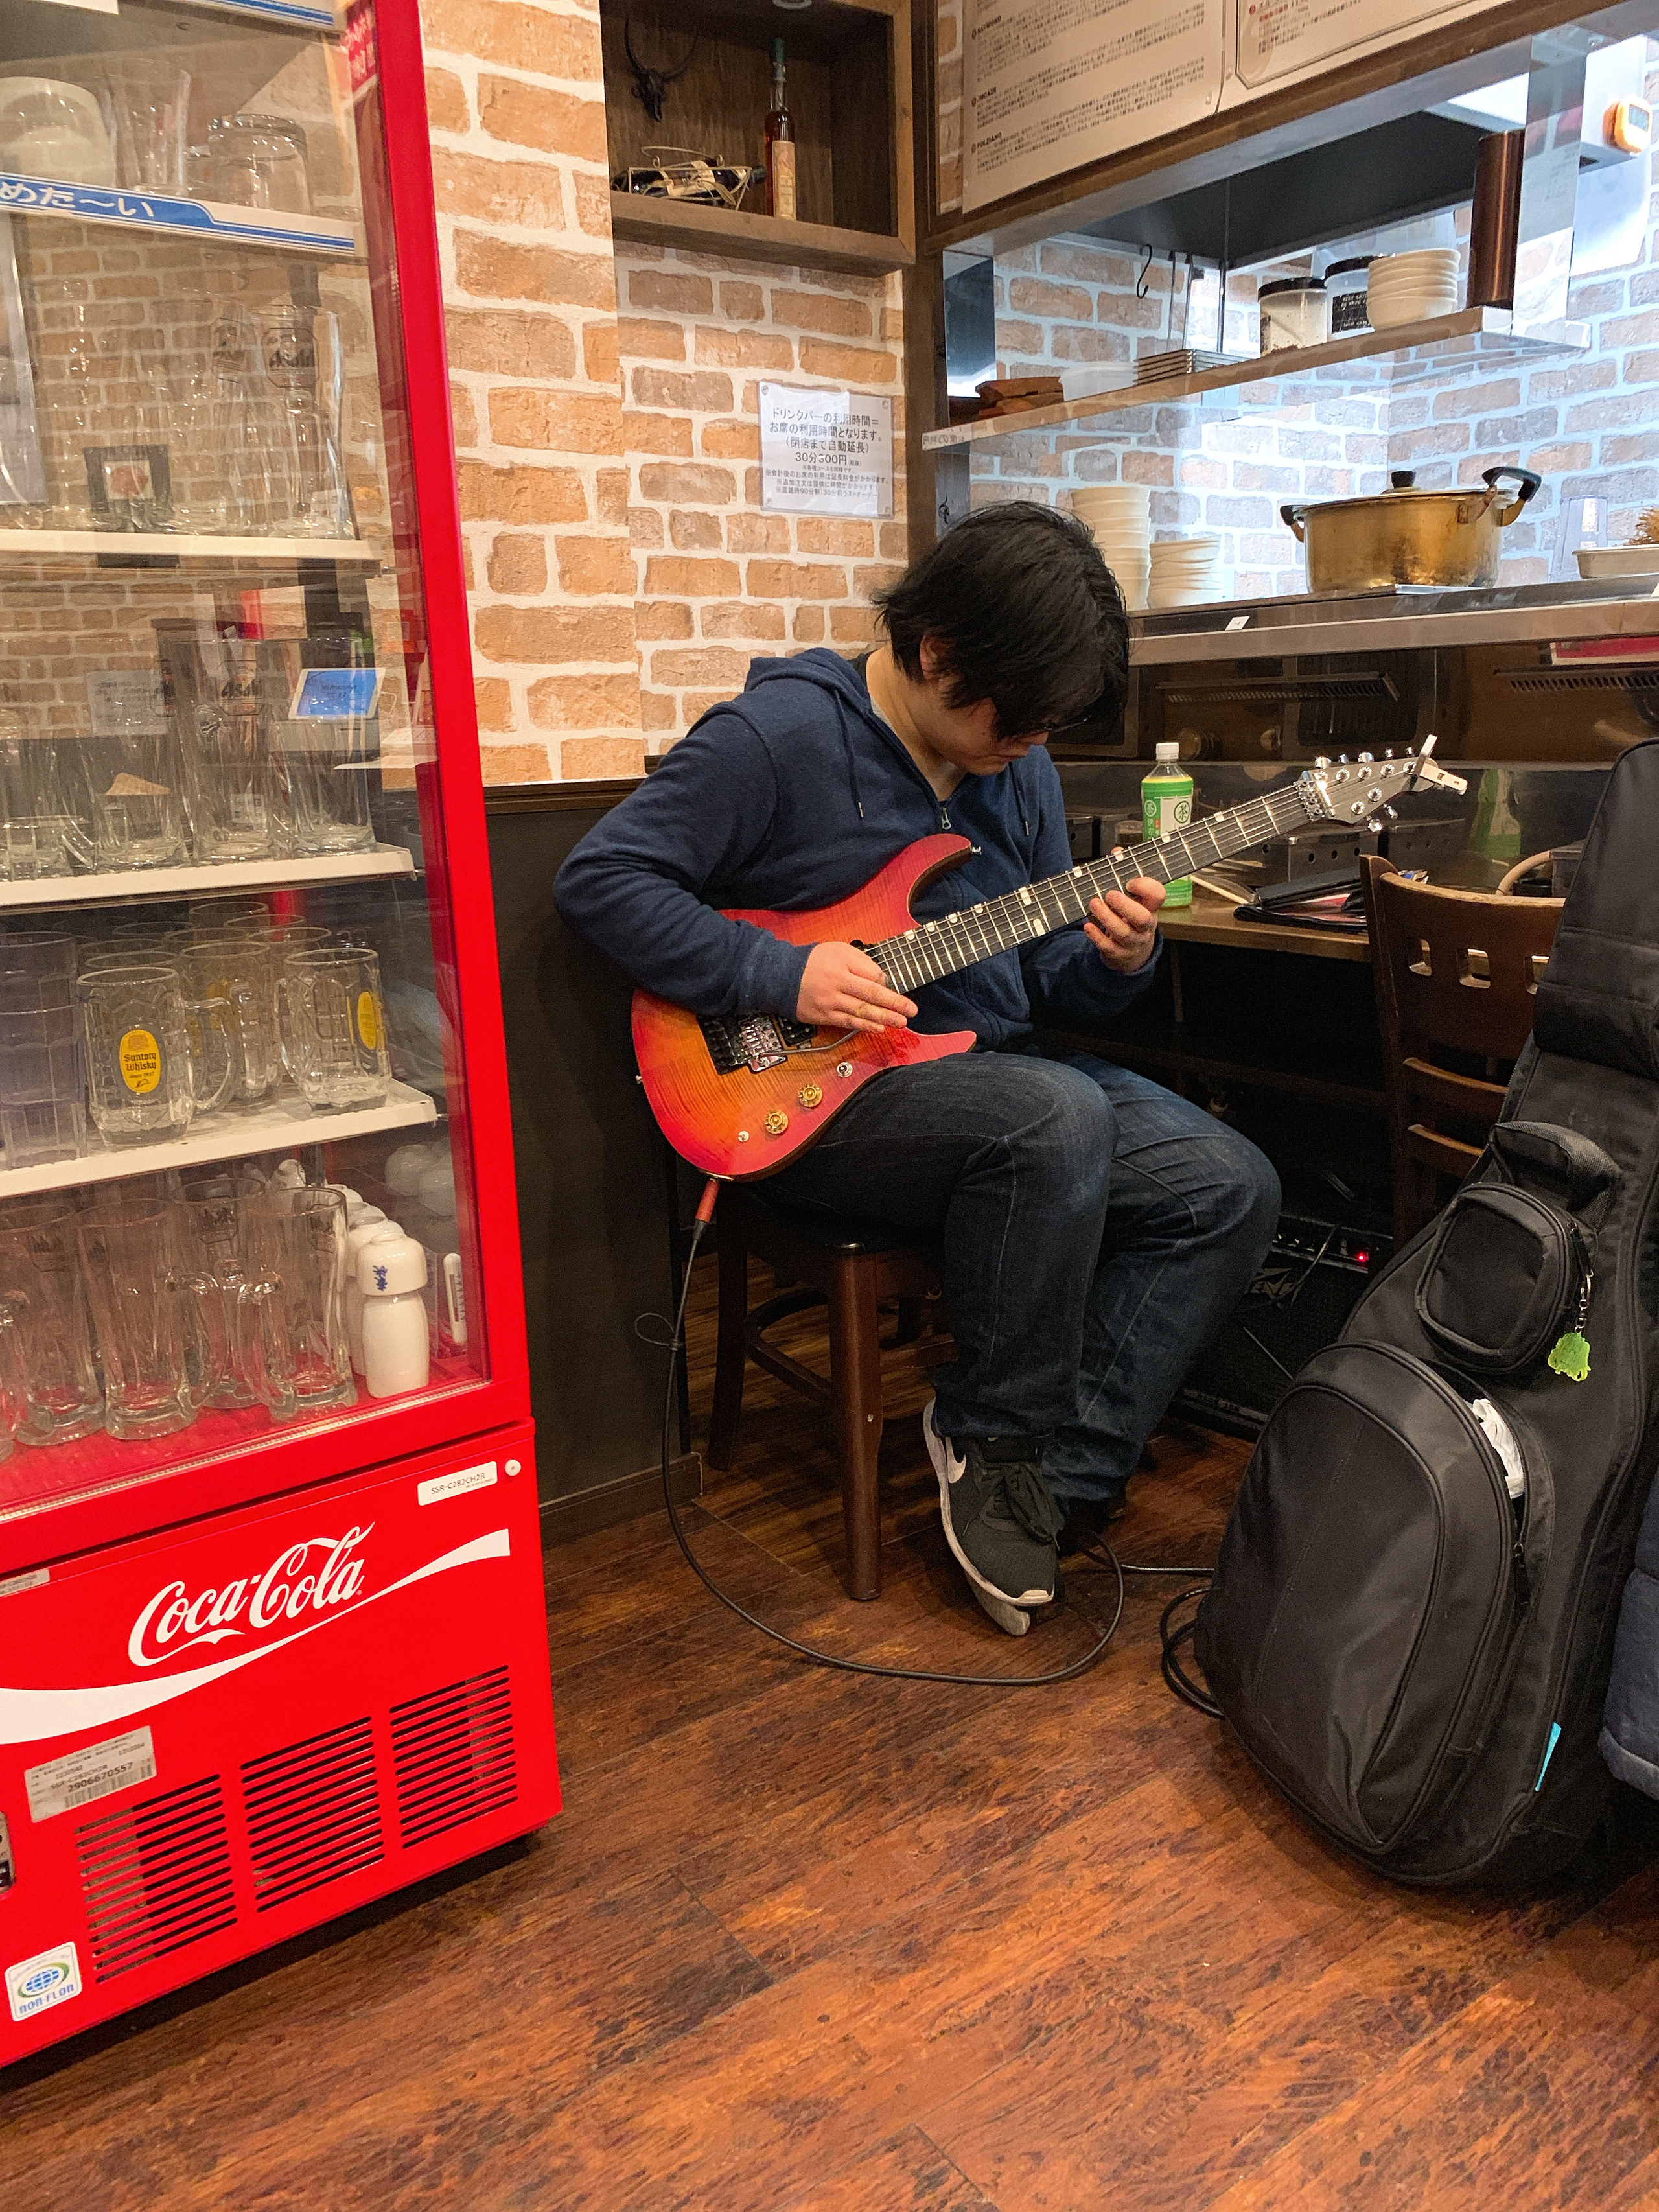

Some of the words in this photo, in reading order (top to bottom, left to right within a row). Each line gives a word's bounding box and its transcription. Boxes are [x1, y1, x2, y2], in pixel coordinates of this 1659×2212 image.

[1178, 804, 1189, 821] 茶
[123, 1052, 157, 1062] Suntory
[125, 1061, 157, 1072] Whisky
[431, 1473, 486, 1495] SSR-C282CH2R
[128, 1520, 376, 1667] Coca-Cola
